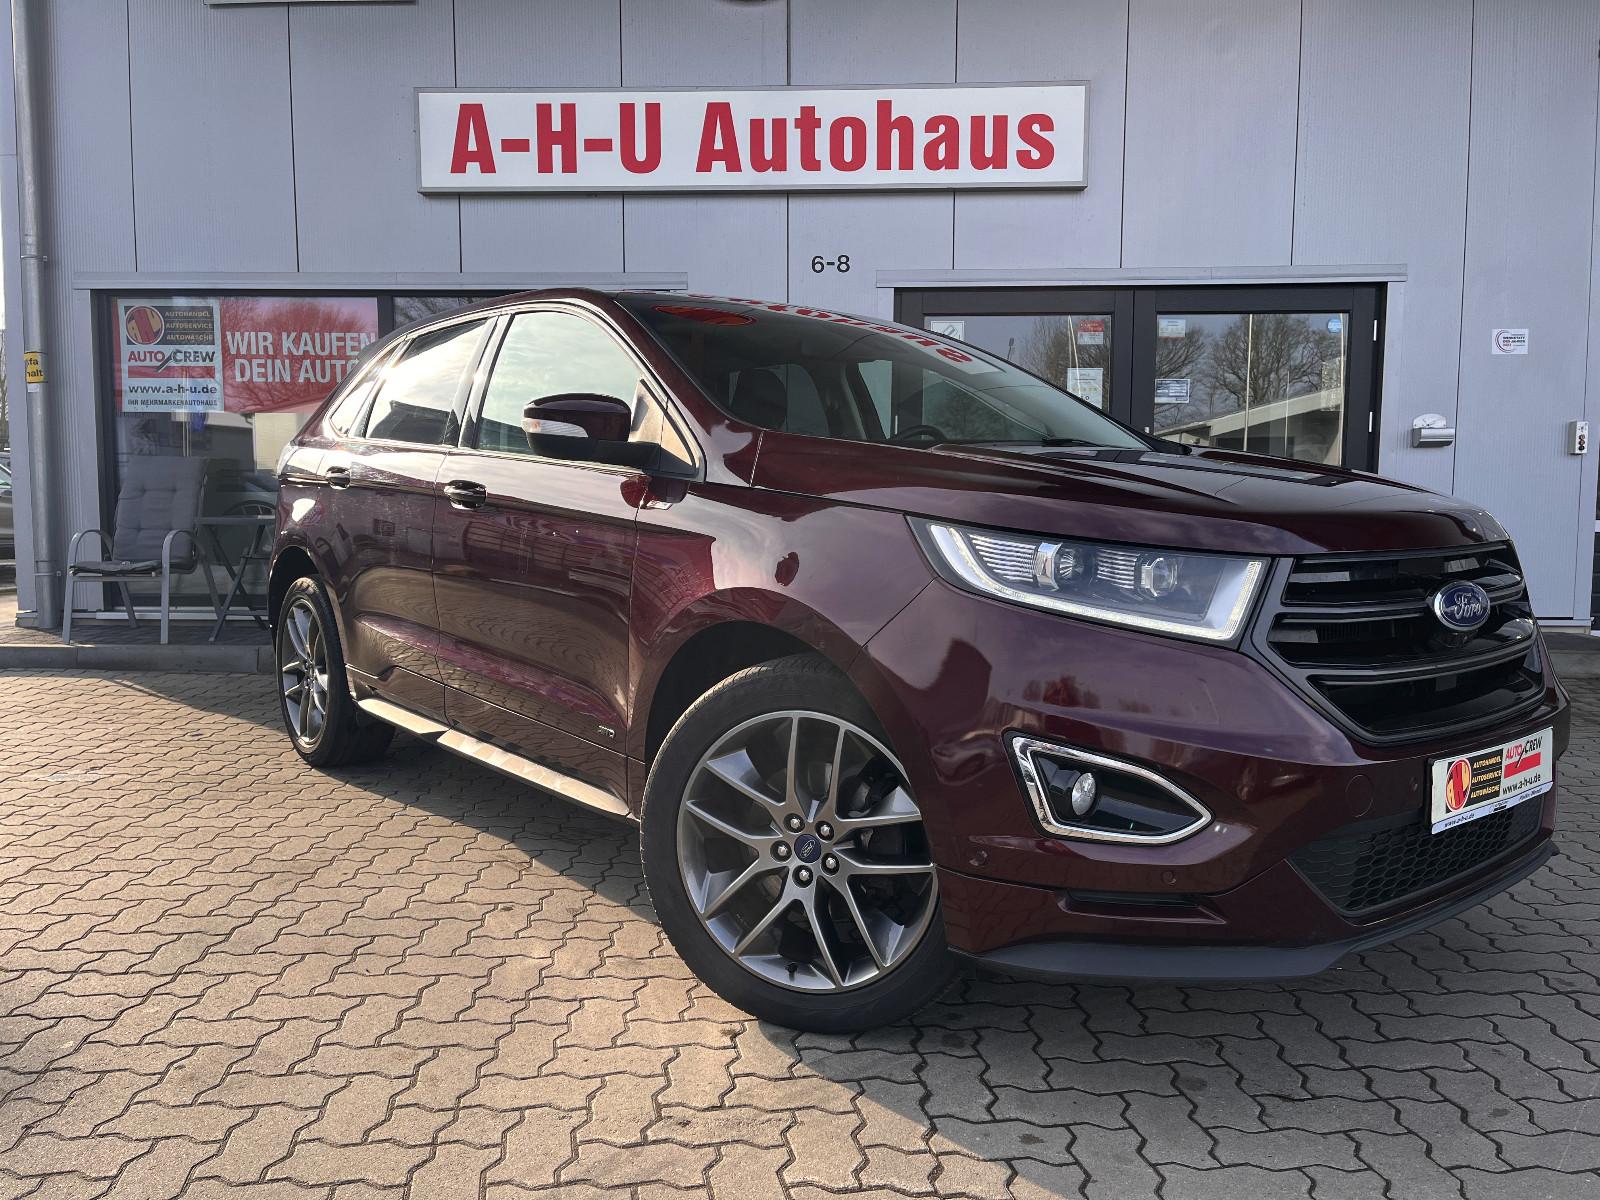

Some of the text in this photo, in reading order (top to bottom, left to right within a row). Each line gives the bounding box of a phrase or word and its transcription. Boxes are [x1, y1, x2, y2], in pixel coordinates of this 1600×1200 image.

[450, 100, 1055, 174] A-H-U Autohaus
[811, 255, 851, 273] 6-8
[226, 331, 376, 356] WIR KAUFEN
[235, 358, 291, 383] DEIN
[129, 384, 217, 394] www.a-h-u.de
[1502, 773, 1541, 795] www.a-h-u.de
